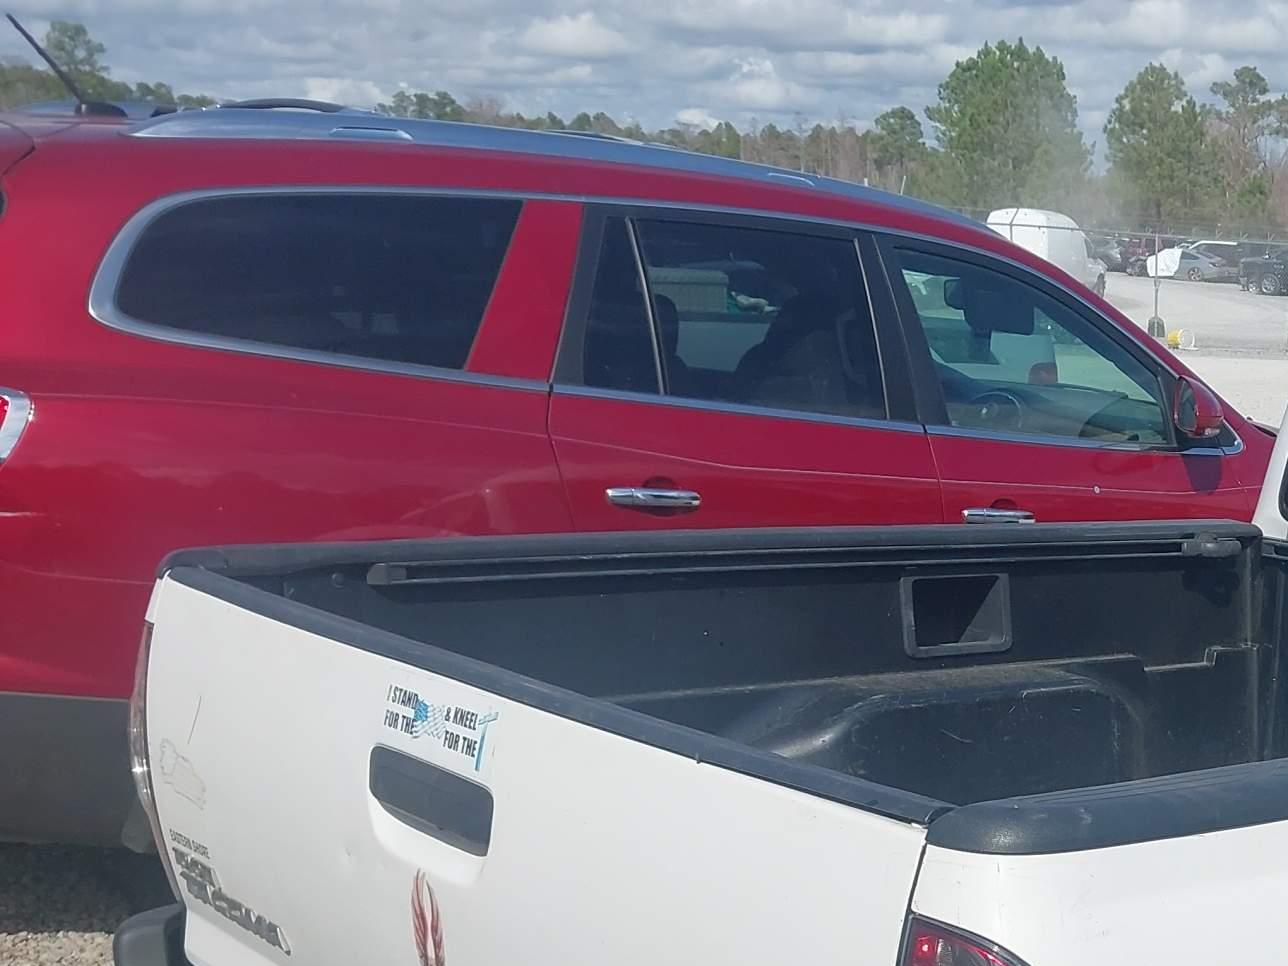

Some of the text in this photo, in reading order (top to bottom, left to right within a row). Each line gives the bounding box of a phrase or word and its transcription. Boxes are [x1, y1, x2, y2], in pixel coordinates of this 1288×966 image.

[392, 686, 419, 710] STAND
[383, 709, 418, 736] FOR THE
[445, 706, 479, 731] & KNEEL
[443, 730, 479, 758] FOR THE
